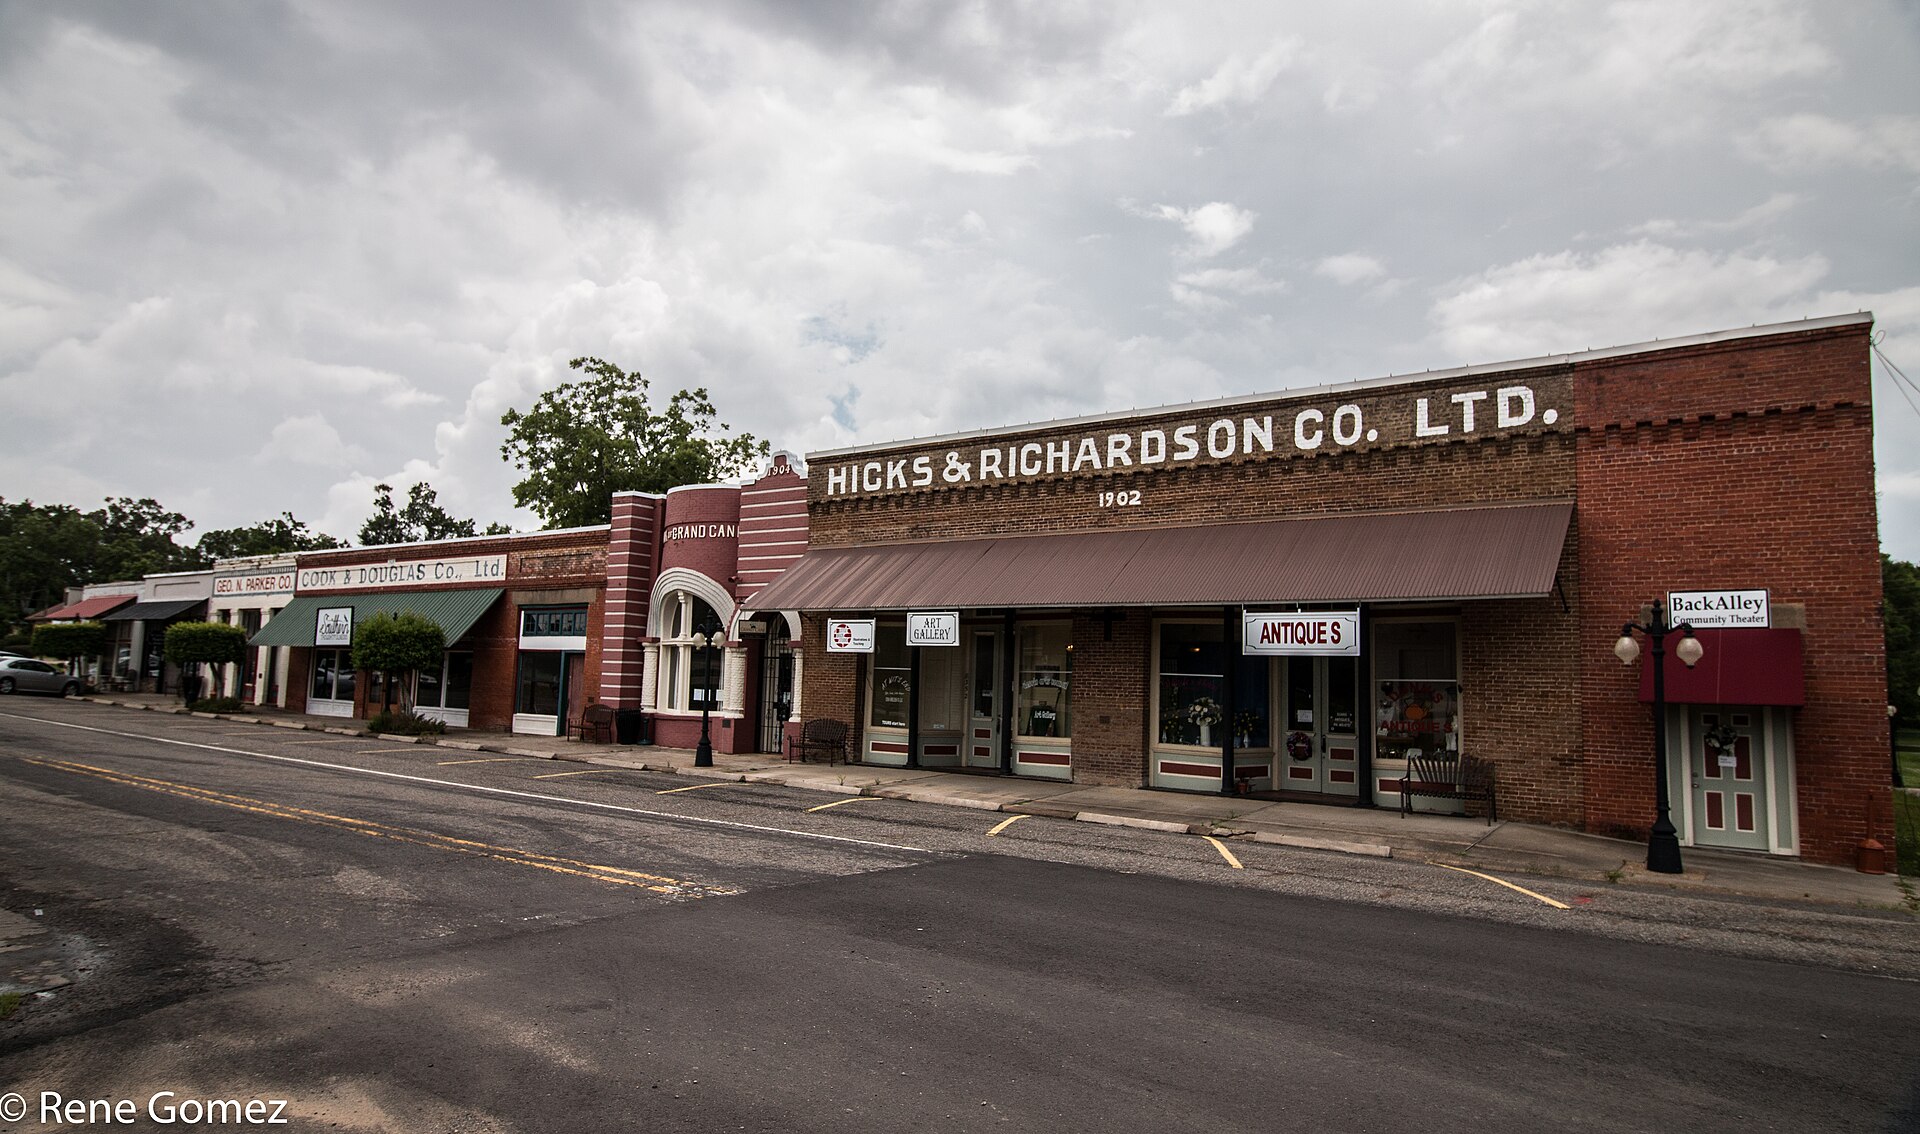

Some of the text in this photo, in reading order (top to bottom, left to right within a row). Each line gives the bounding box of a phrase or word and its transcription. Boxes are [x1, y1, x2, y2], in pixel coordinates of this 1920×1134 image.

[827, 385, 1559, 496] HICKS & RICHARDSON CO. LTD.
[768, 465, 790, 476] 1904
[1099, 490, 1141, 507] 1902
[673, 525, 706, 540] GRAND
[302, 570, 337, 588] COOK
[343, 569, 352, 585] &
[359, 562, 426, 585] DOUGLAS
[474, 558, 505, 578] Ltd.
[216, 578, 233, 593] GEO.
[245, 576, 277, 591] PARKER
[277, 575, 293, 590] CO.
[1672, 595, 1763, 614] BackAlley
[924, 618, 941, 629] ART
[1673, 614, 1765, 625] Community Theater
[914, 627, 951, 640] GALLERY
[1260, 622, 1341, 645] ANTIQUES
